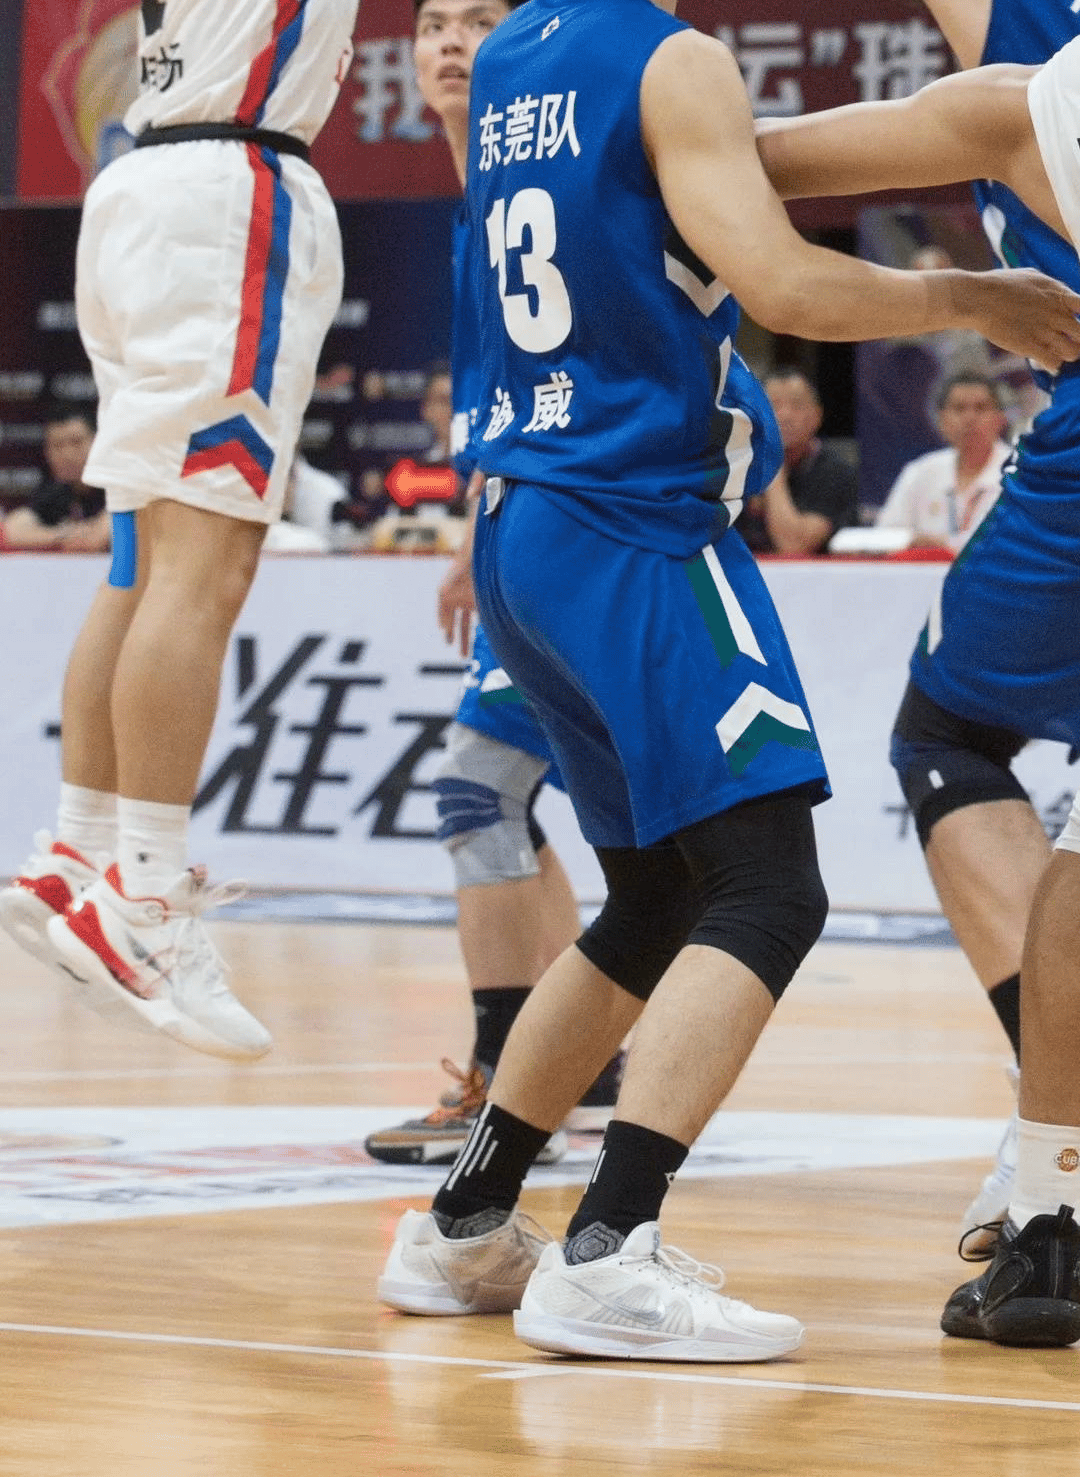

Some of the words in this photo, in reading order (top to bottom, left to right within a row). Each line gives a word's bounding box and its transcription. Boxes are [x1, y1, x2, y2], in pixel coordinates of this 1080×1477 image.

[479, 90, 581, 171] 东莞队
[485, 187, 573, 354] 13
